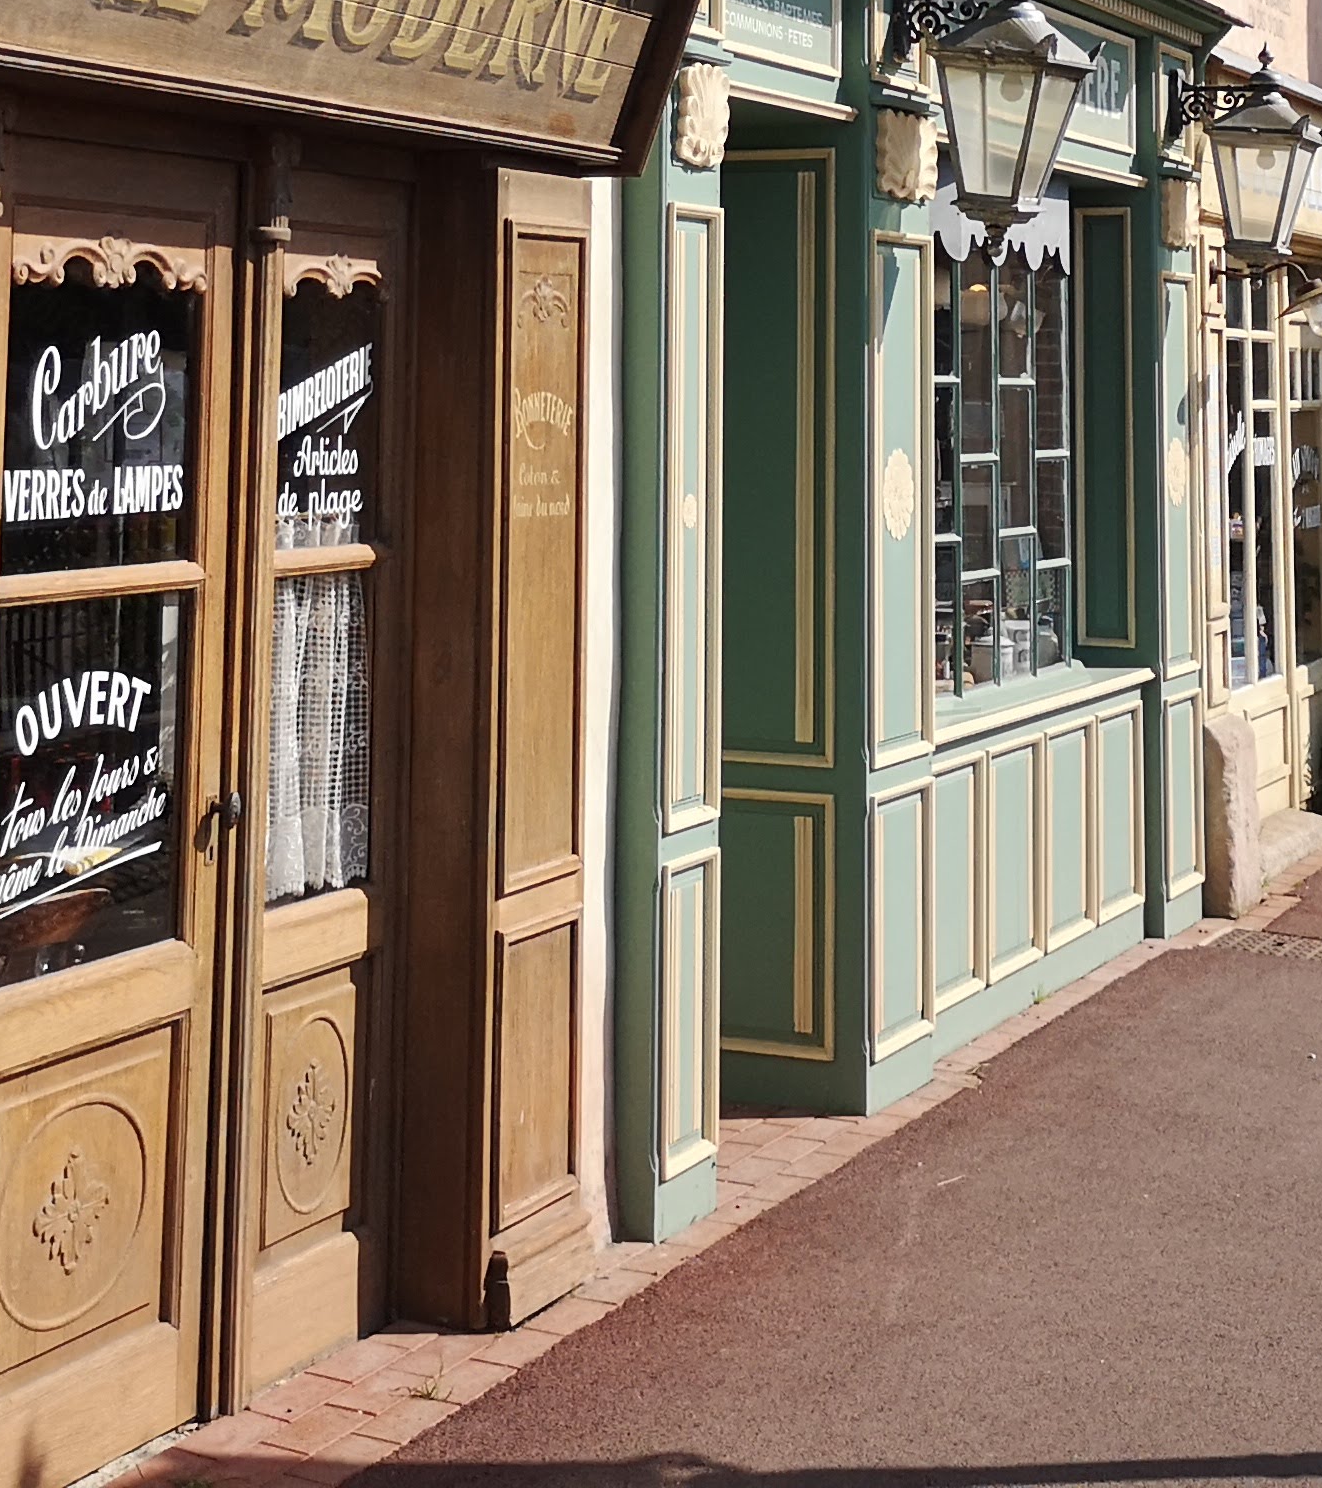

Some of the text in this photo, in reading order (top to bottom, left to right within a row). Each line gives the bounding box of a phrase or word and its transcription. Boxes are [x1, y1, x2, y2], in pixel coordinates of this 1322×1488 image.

[725, 10, 814, 48] COMMUNIONS FETES
[32, 330, 163, 450] Carbure
[277, 342, 373, 442] BIMBELOTERIE
[514, 387, 573, 448] BONNETERIE
[293, 434, 359, 478] Articles
[3, 464, 184, 523] VERRES de LAMPES
[278, 478, 364, 531] de plage
[15, 671, 152, 756] OUVERT
[46, 765, 82, 826] les
[143, 746, 159, 776] &
[44, 826, 68, 878] le
